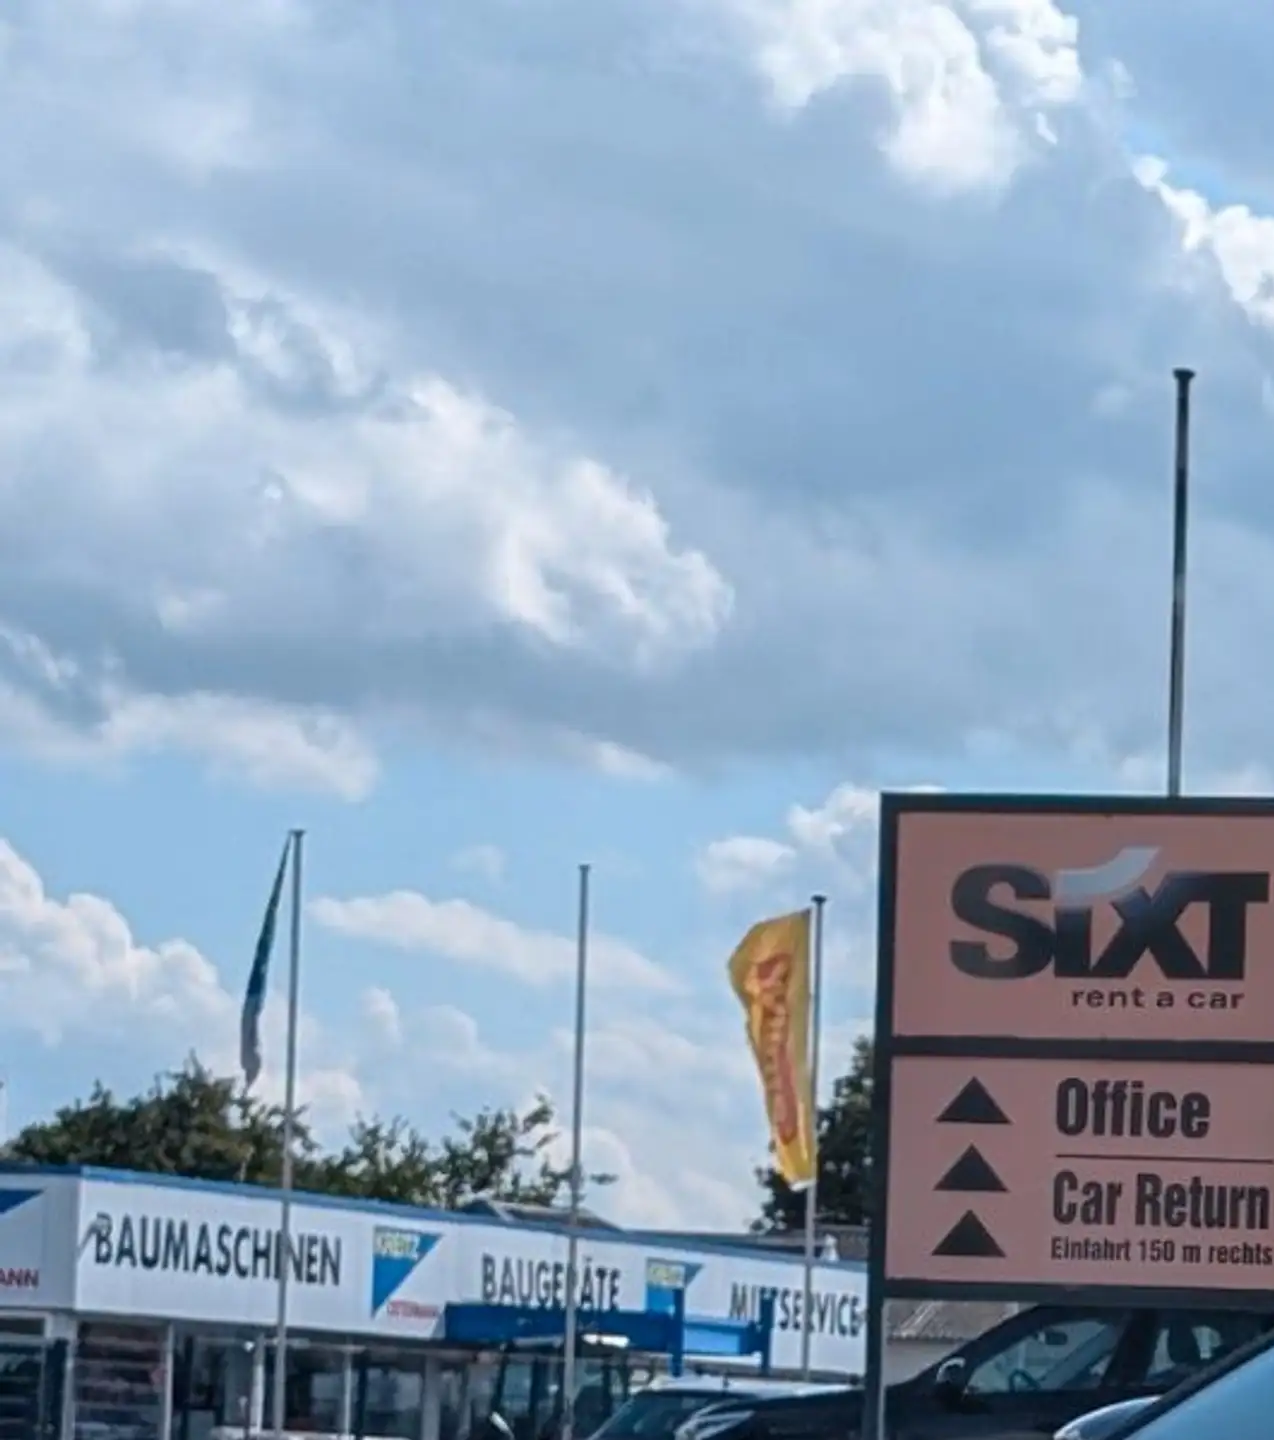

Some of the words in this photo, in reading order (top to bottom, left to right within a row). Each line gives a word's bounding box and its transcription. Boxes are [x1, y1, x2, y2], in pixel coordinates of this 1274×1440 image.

[1072, 988, 1144, 1008] rent
[1156, 992, 1174, 1008] a
[1187, 992, 1244, 1009] car
[1056, 1077, 1210, 1138] Office
[1053, 1170, 1123, 1225] Car
[1136, 1173, 1269, 1230] Return
[92, 1211, 342, 1286] BAUMASCHINEN
[1051, 1237, 1131, 1264] Einfahrt
[1139, 1238, 1174, 1263] 150
[1182, 1246, 1201, 1264] m
[1208, 1241, 1273, 1266] rechts
[730, 1282, 863, 1337] MISERVICE
